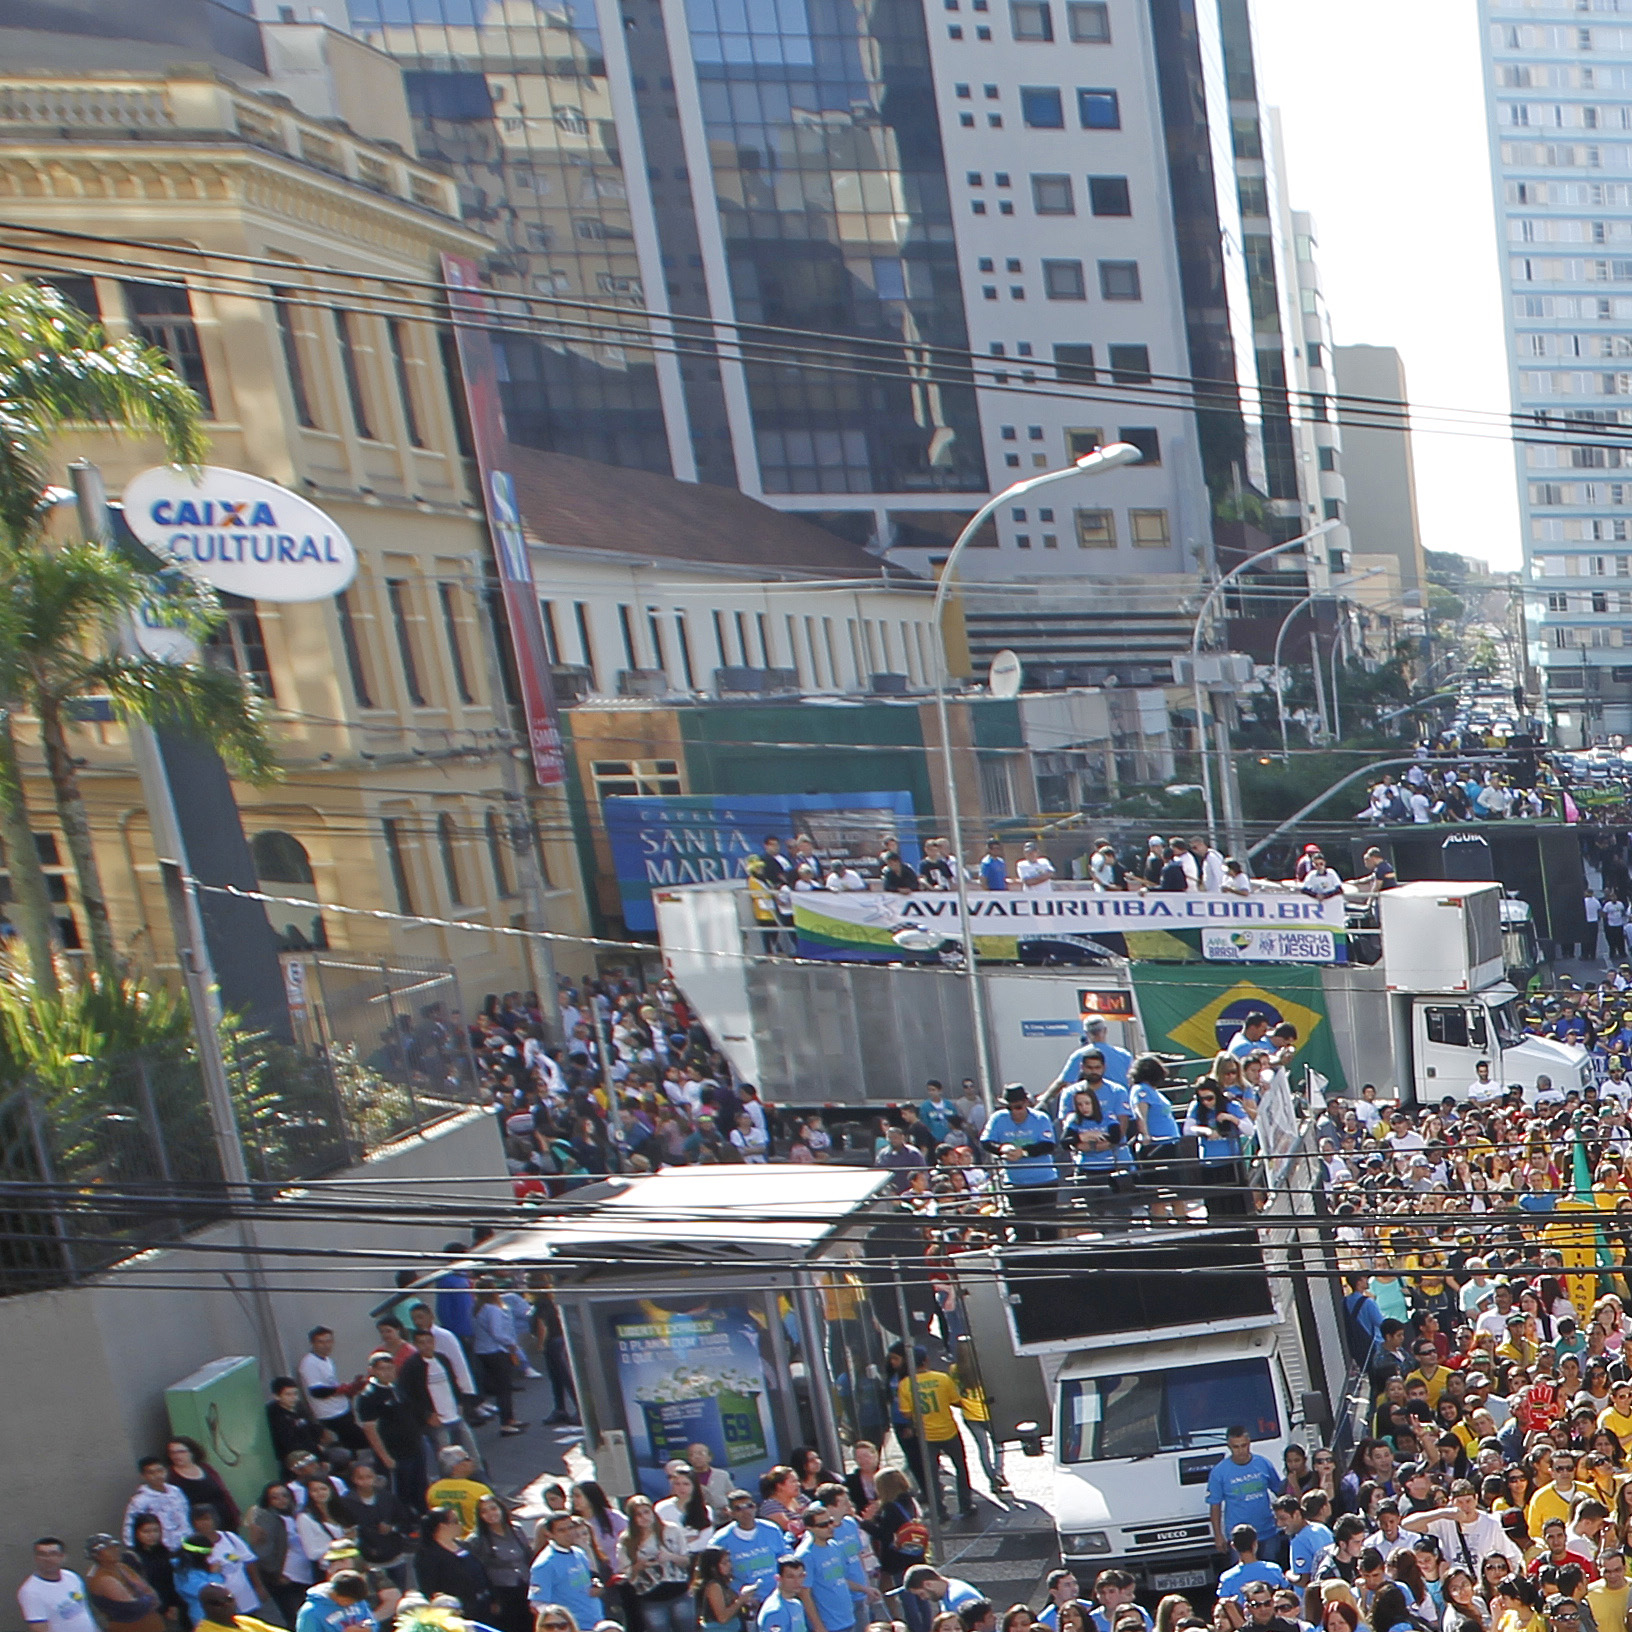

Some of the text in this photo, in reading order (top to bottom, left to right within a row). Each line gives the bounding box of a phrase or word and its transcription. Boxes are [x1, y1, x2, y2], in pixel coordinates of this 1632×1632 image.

[151, 499, 277, 527] CAIXA
[168, 533, 341, 563] CULTURAL
[640, 828, 752, 855] SANTA
[1157, 1531, 1187, 1539] IVECO
